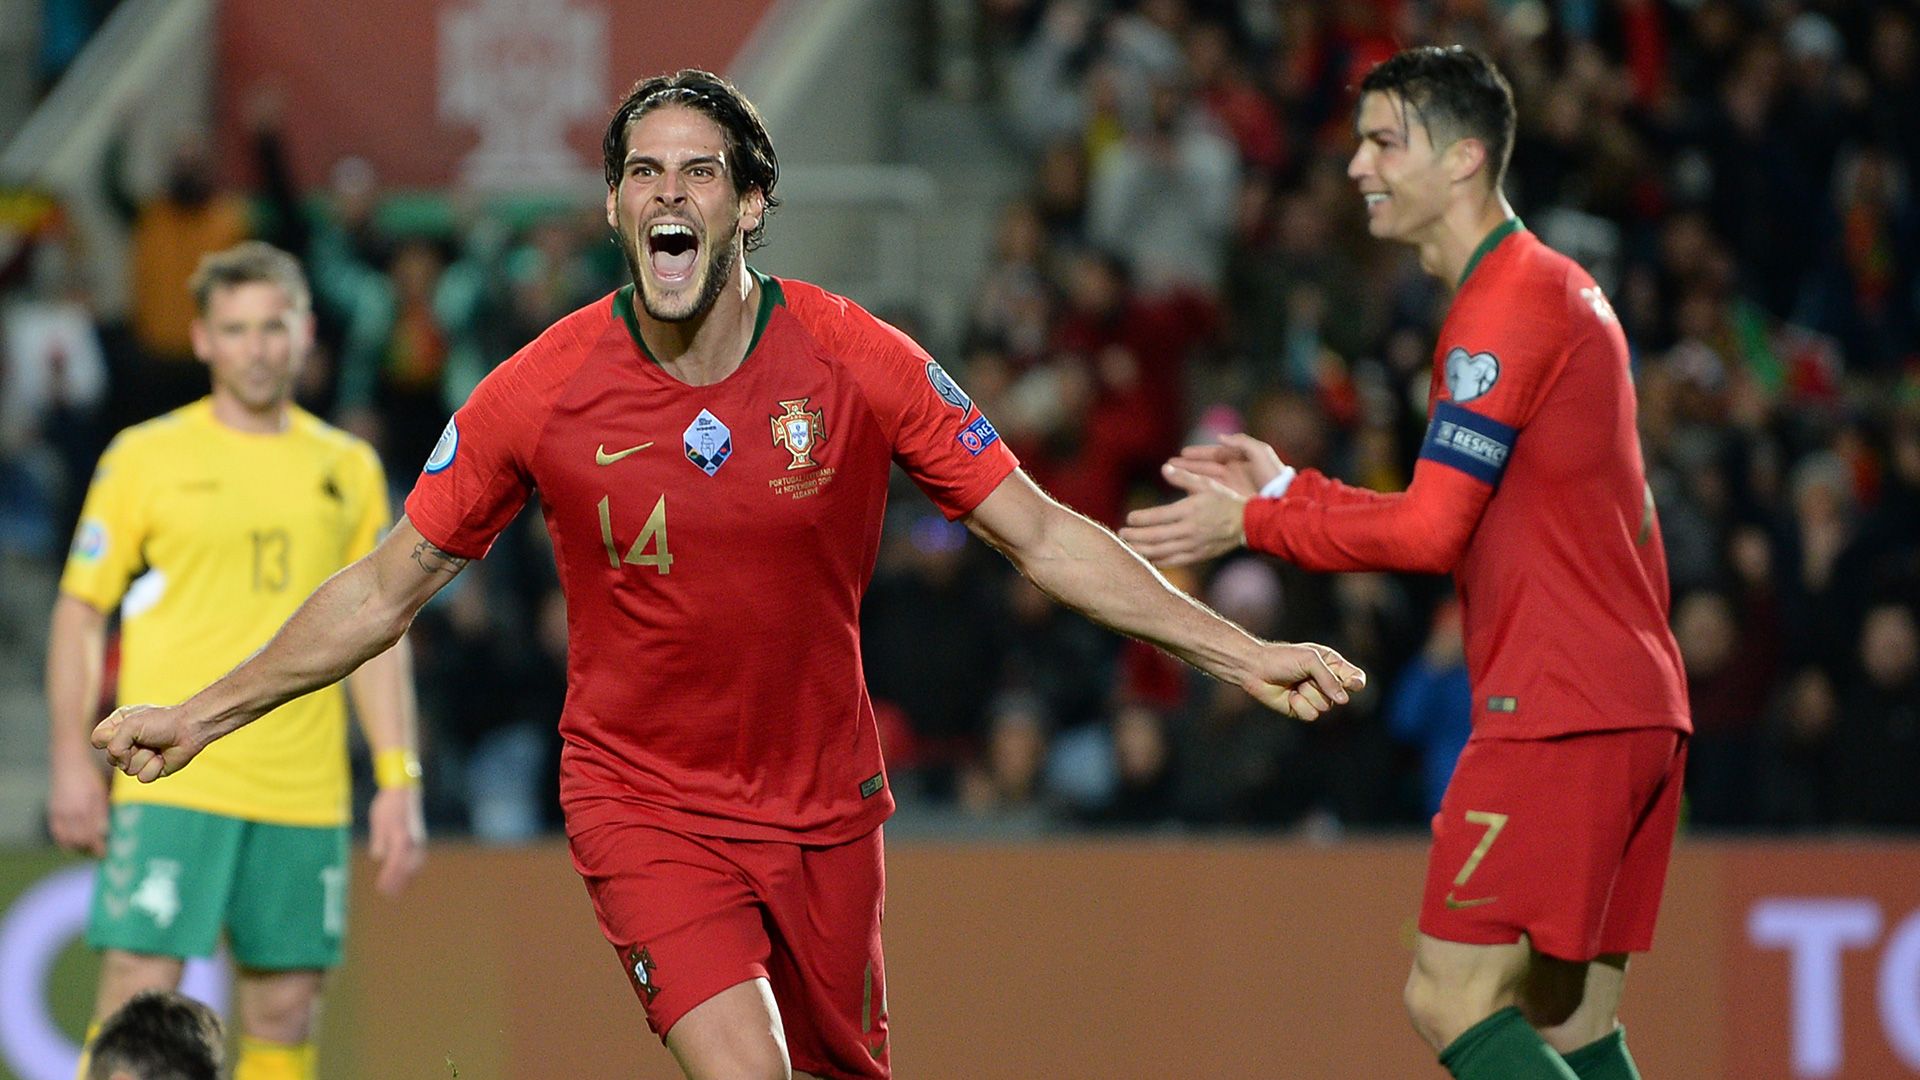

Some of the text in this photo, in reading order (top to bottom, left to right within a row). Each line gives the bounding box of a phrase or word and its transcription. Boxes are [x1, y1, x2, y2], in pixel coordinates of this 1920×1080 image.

[247, 527, 291, 593] 13
[597, 492, 673, 574] 14
[1454, 810, 1508, 886] 7
